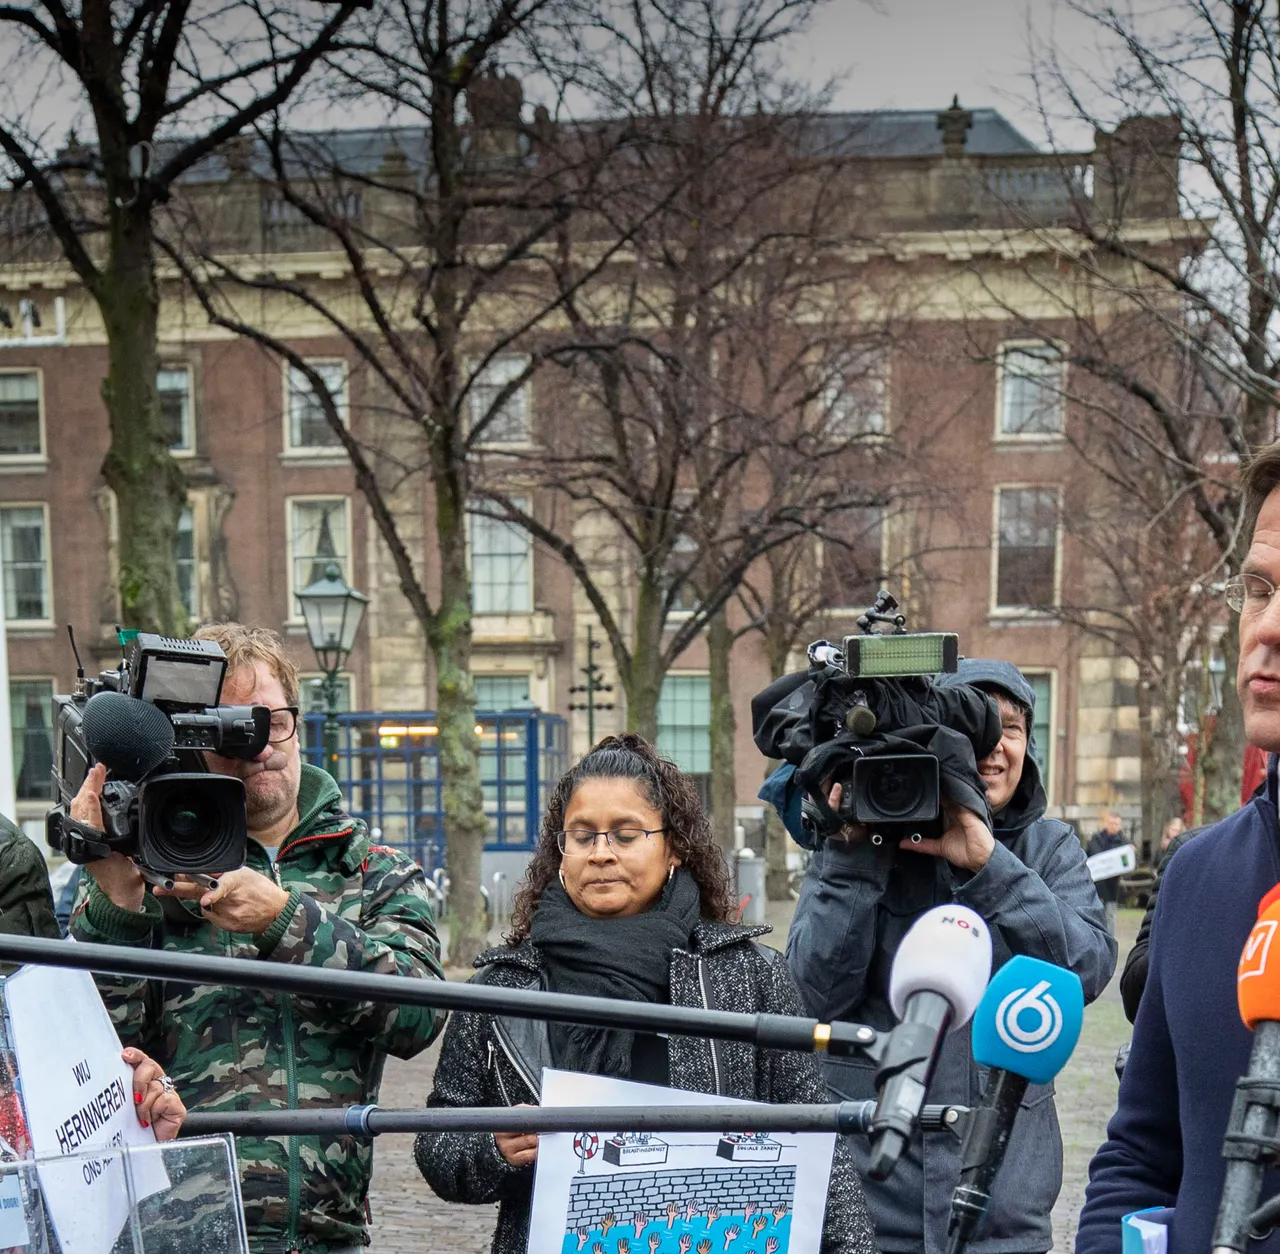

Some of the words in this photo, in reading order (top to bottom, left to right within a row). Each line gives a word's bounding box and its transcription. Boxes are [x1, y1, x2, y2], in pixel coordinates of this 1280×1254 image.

[941, 916, 980, 938] NOS
[72, 1059, 92, 1087] WIJ
[55, 1076, 127, 1155] HERINNEREN
[82, 1160, 102, 1186] ONS
